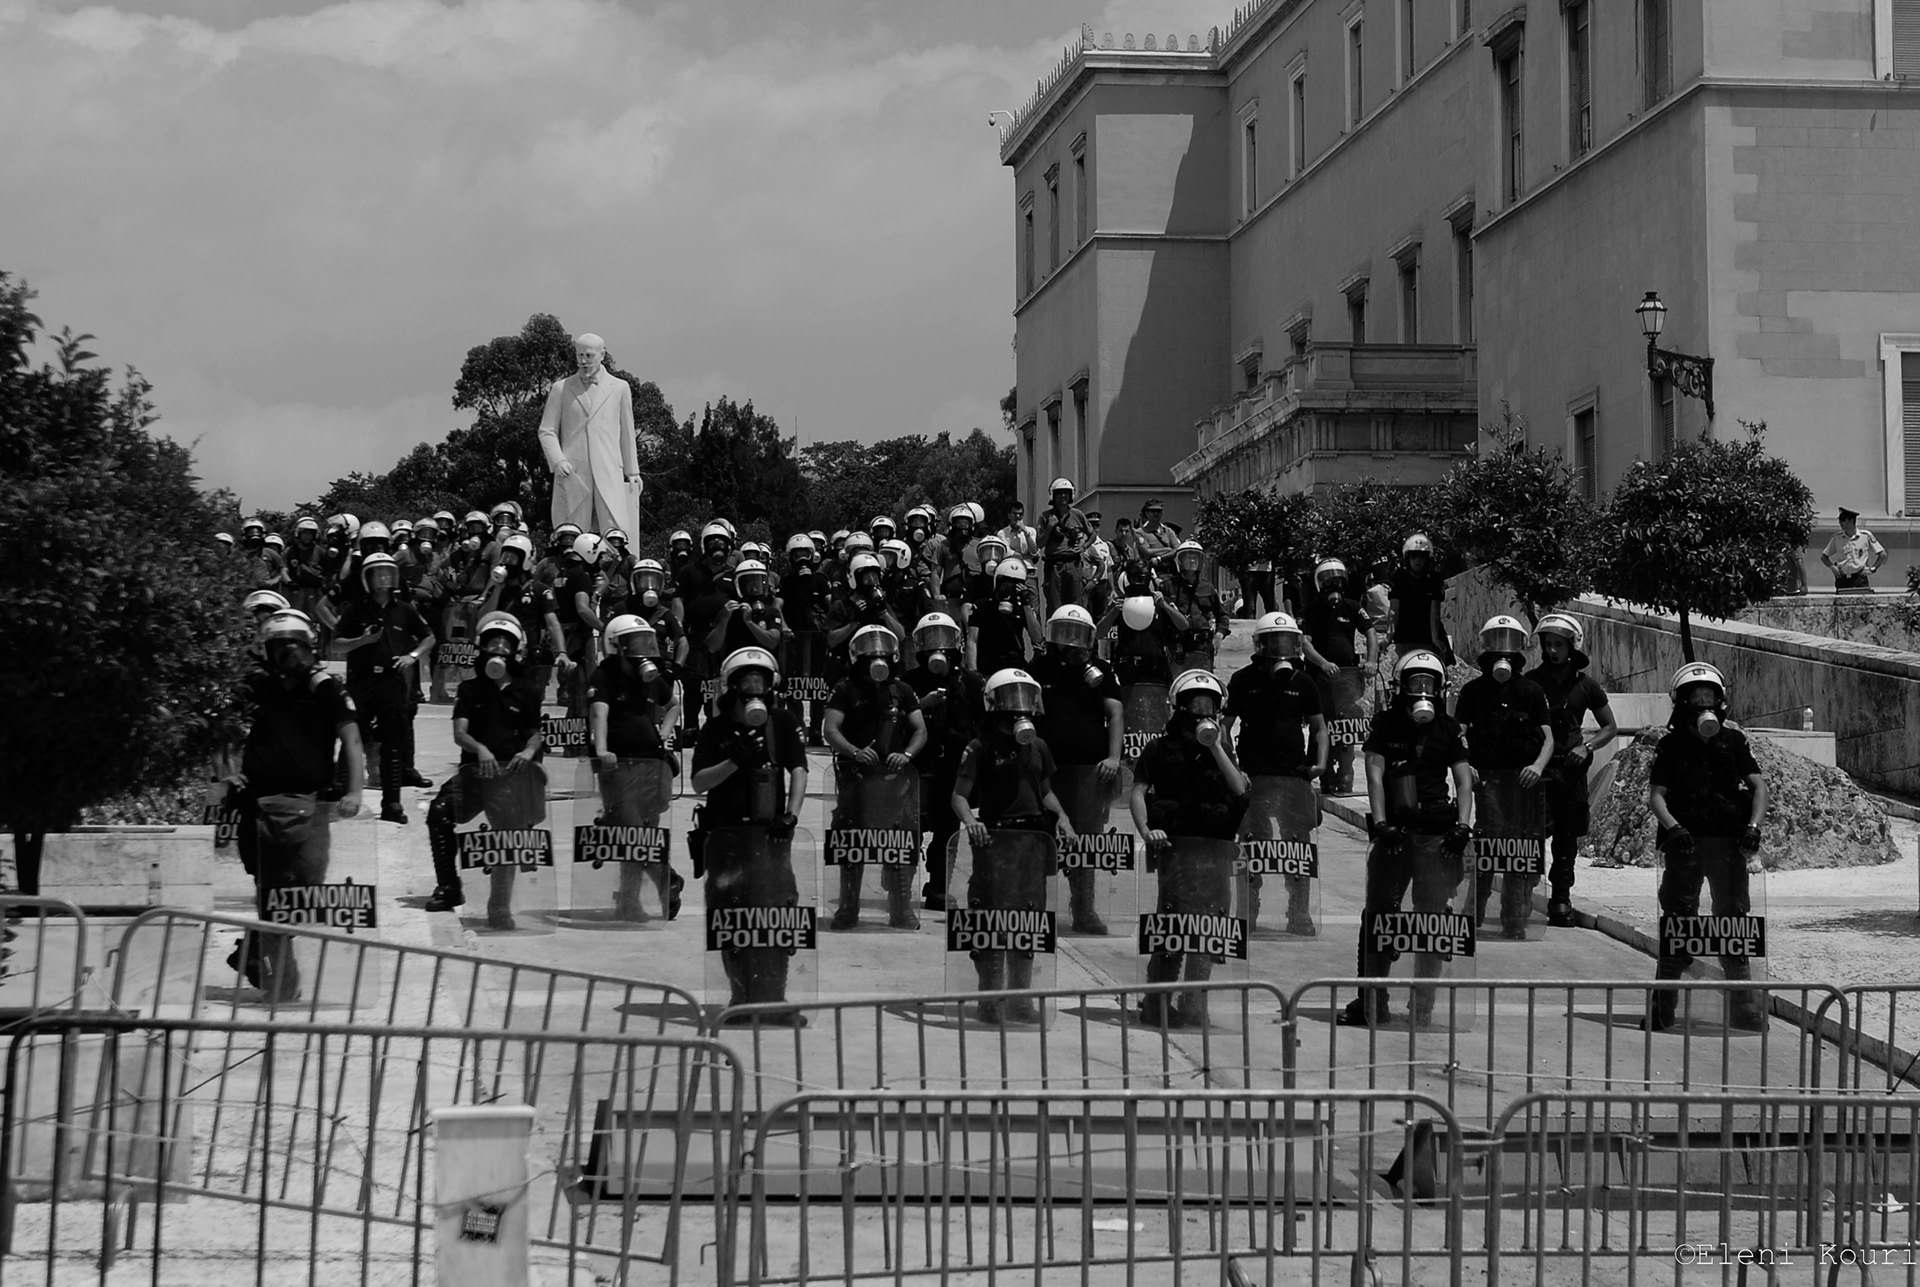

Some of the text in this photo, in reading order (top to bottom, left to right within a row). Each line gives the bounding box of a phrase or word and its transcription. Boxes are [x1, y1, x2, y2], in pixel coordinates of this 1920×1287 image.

[437, 654, 476, 666] POLICE
[787, 676, 829, 690] ΣΤΥΝΟΜ
[783, 689, 828, 701] POLIC
[541, 717, 587, 734] ΣΤΥΝΟΜΙΑ
[1327, 717, 1371, 735] ΑΣΤΥΝΟ
[1330, 732, 1370, 747] POL
[463, 830, 549, 852] ΑΣΤΥΝΟΜΙΑ
[578, 826, 666, 848] ΑΣΤΥΝΟΜΙΑ
[829, 828, 915, 850] ΑΣΤΥΝΟΜΙΑ
[1057, 834, 1131, 854] ΣΥΝΟΜΙΑ
[467, 849, 547, 867] POLICE
[581, 844, 662, 863] POLICE
[832, 847, 911, 865] POLICE
[1238, 840, 1314, 863] ΣΤΥΝΟΜΙΑ
[1469, 838, 1542, 859] ΤΥΝΟΜΙΑ
[1056, 852, 1128, 869] POLICE
[1231, 857, 1311, 877] POLICE
[1462, 856, 1538, 874] POLICE
[266, 886, 373, 911] ΑΣΤΥΝΟΜΙΑ
[270, 908, 369, 927] POLICE
[711, 906, 812, 931] ΑΣΤΥΝΟΜΙΑ
[951, 909, 1051, 935] ΑΣΤΥΝΟΜΙΑ
[1144, 913, 1243, 941] ΑΣΤΥΝΟΜΙΑ
[1373, 912, 1471, 939] ΑΣΤΥΝΟΜΙΑ
[1664, 916, 1760, 939] ΑΣΤΥΝΟΜΙΑ
[715, 929, 808, 949] POLICE
[955, 931, 1046, 951] POLICE
[1149, 935, 1238, 958] POLICE
[1377, 935, 1466, 955] POLICE
[1669, 937, 1758, 956] POLICE
